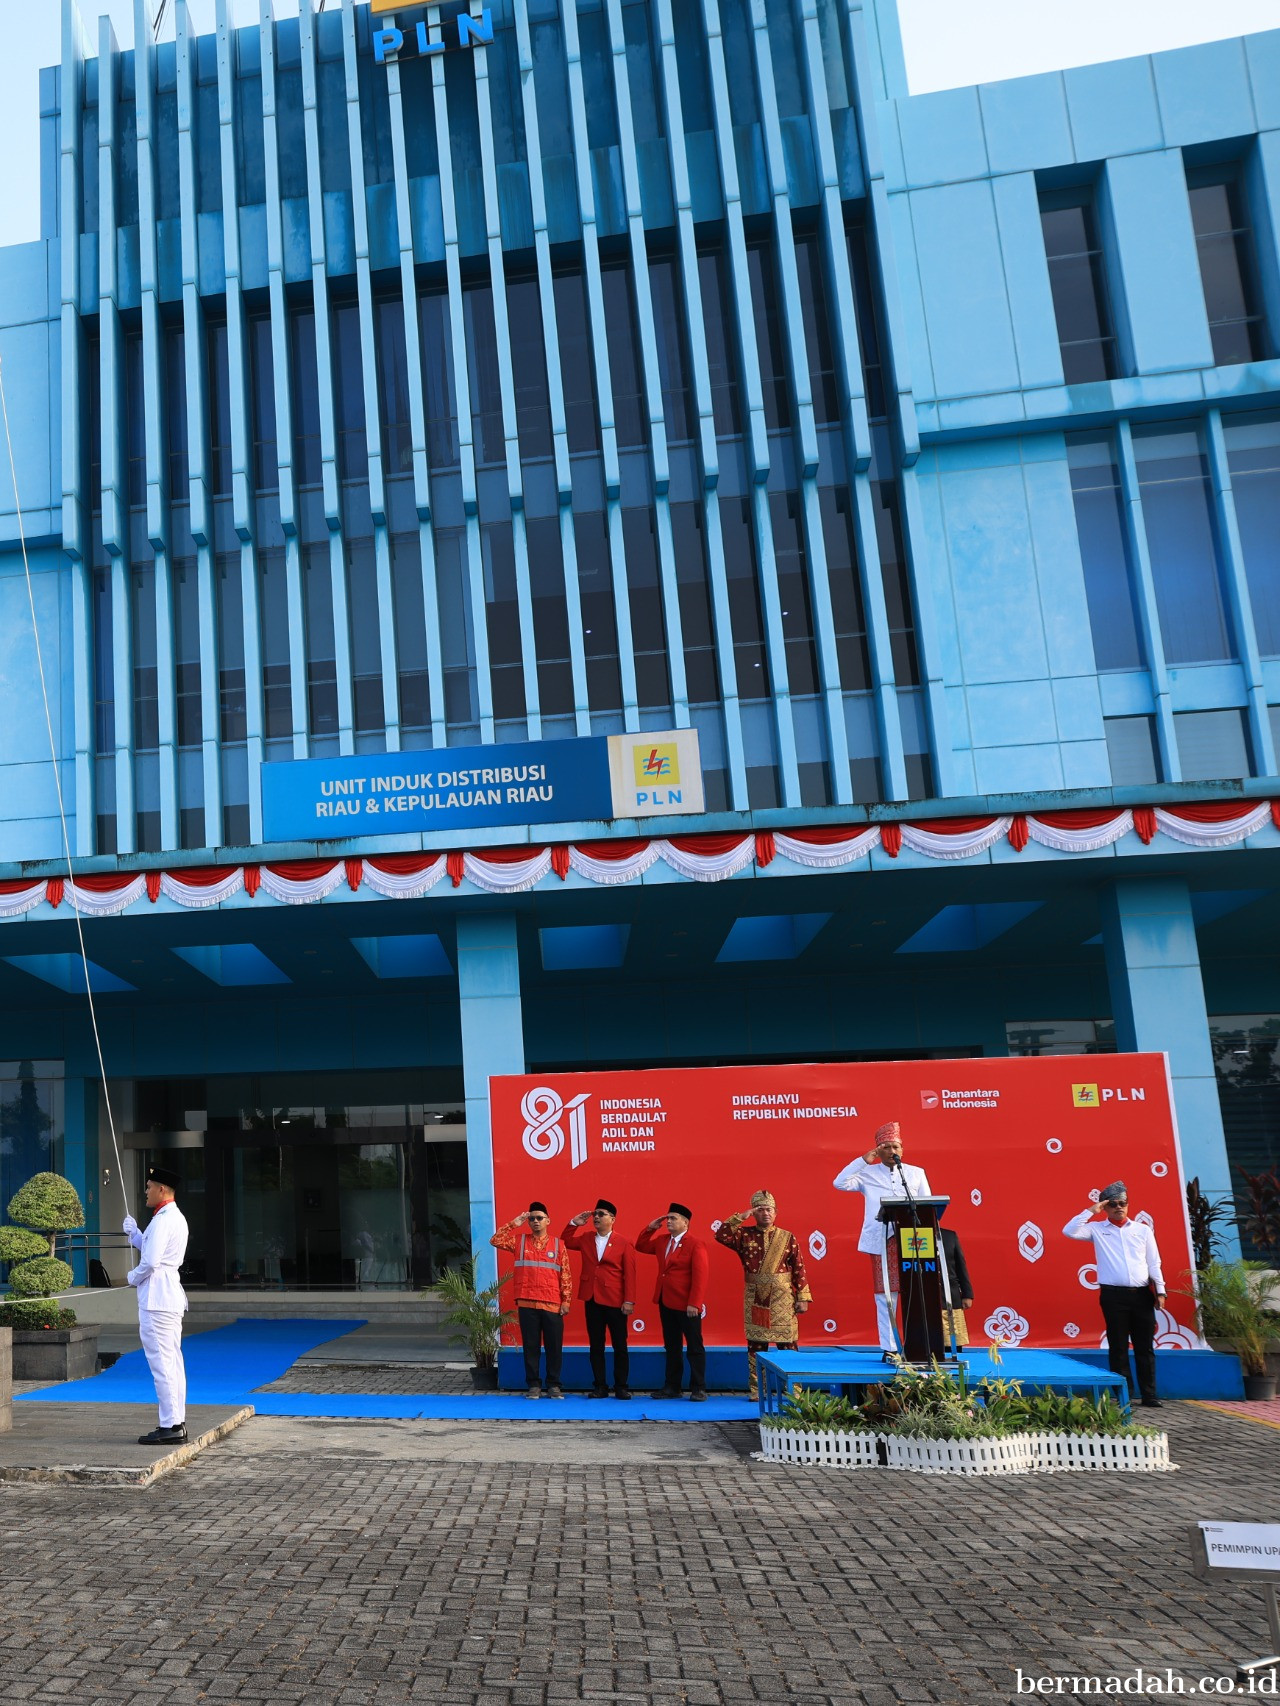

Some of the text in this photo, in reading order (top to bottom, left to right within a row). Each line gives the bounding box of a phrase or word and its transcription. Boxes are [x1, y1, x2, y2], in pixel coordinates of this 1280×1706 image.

[373, 8, 494, 64] PLN
[321, 764, 546, 797] UNIT INDUK DISTRIBUSI
[316, 785, 553, 818] RIAU & KEPULAUAN RIAU
[636, 790, 682, 806] PLN
[941, 1089, 1000, 1098] Danantara
[1102, 1087, 1145, 1101] PLN
[600, 1098, 662, 1110] INDONESIA
[732, 1094, 799, 1106] DIRGAHAYU
[942, 1098, 997, 1108] Indonesia
[601, 1112, 667, 1124] BERDAULAT
[733, 1106, 858, 1120] REPUBLIK INDONESIA
[521, 1087, 592, 1169] 81
[602, 1127, 654, 1138] ADIL DAN
[602, 1141, 655, 1152] MAKMUR
[1211, 1543, 1262, 1554] PEMIMPIN
